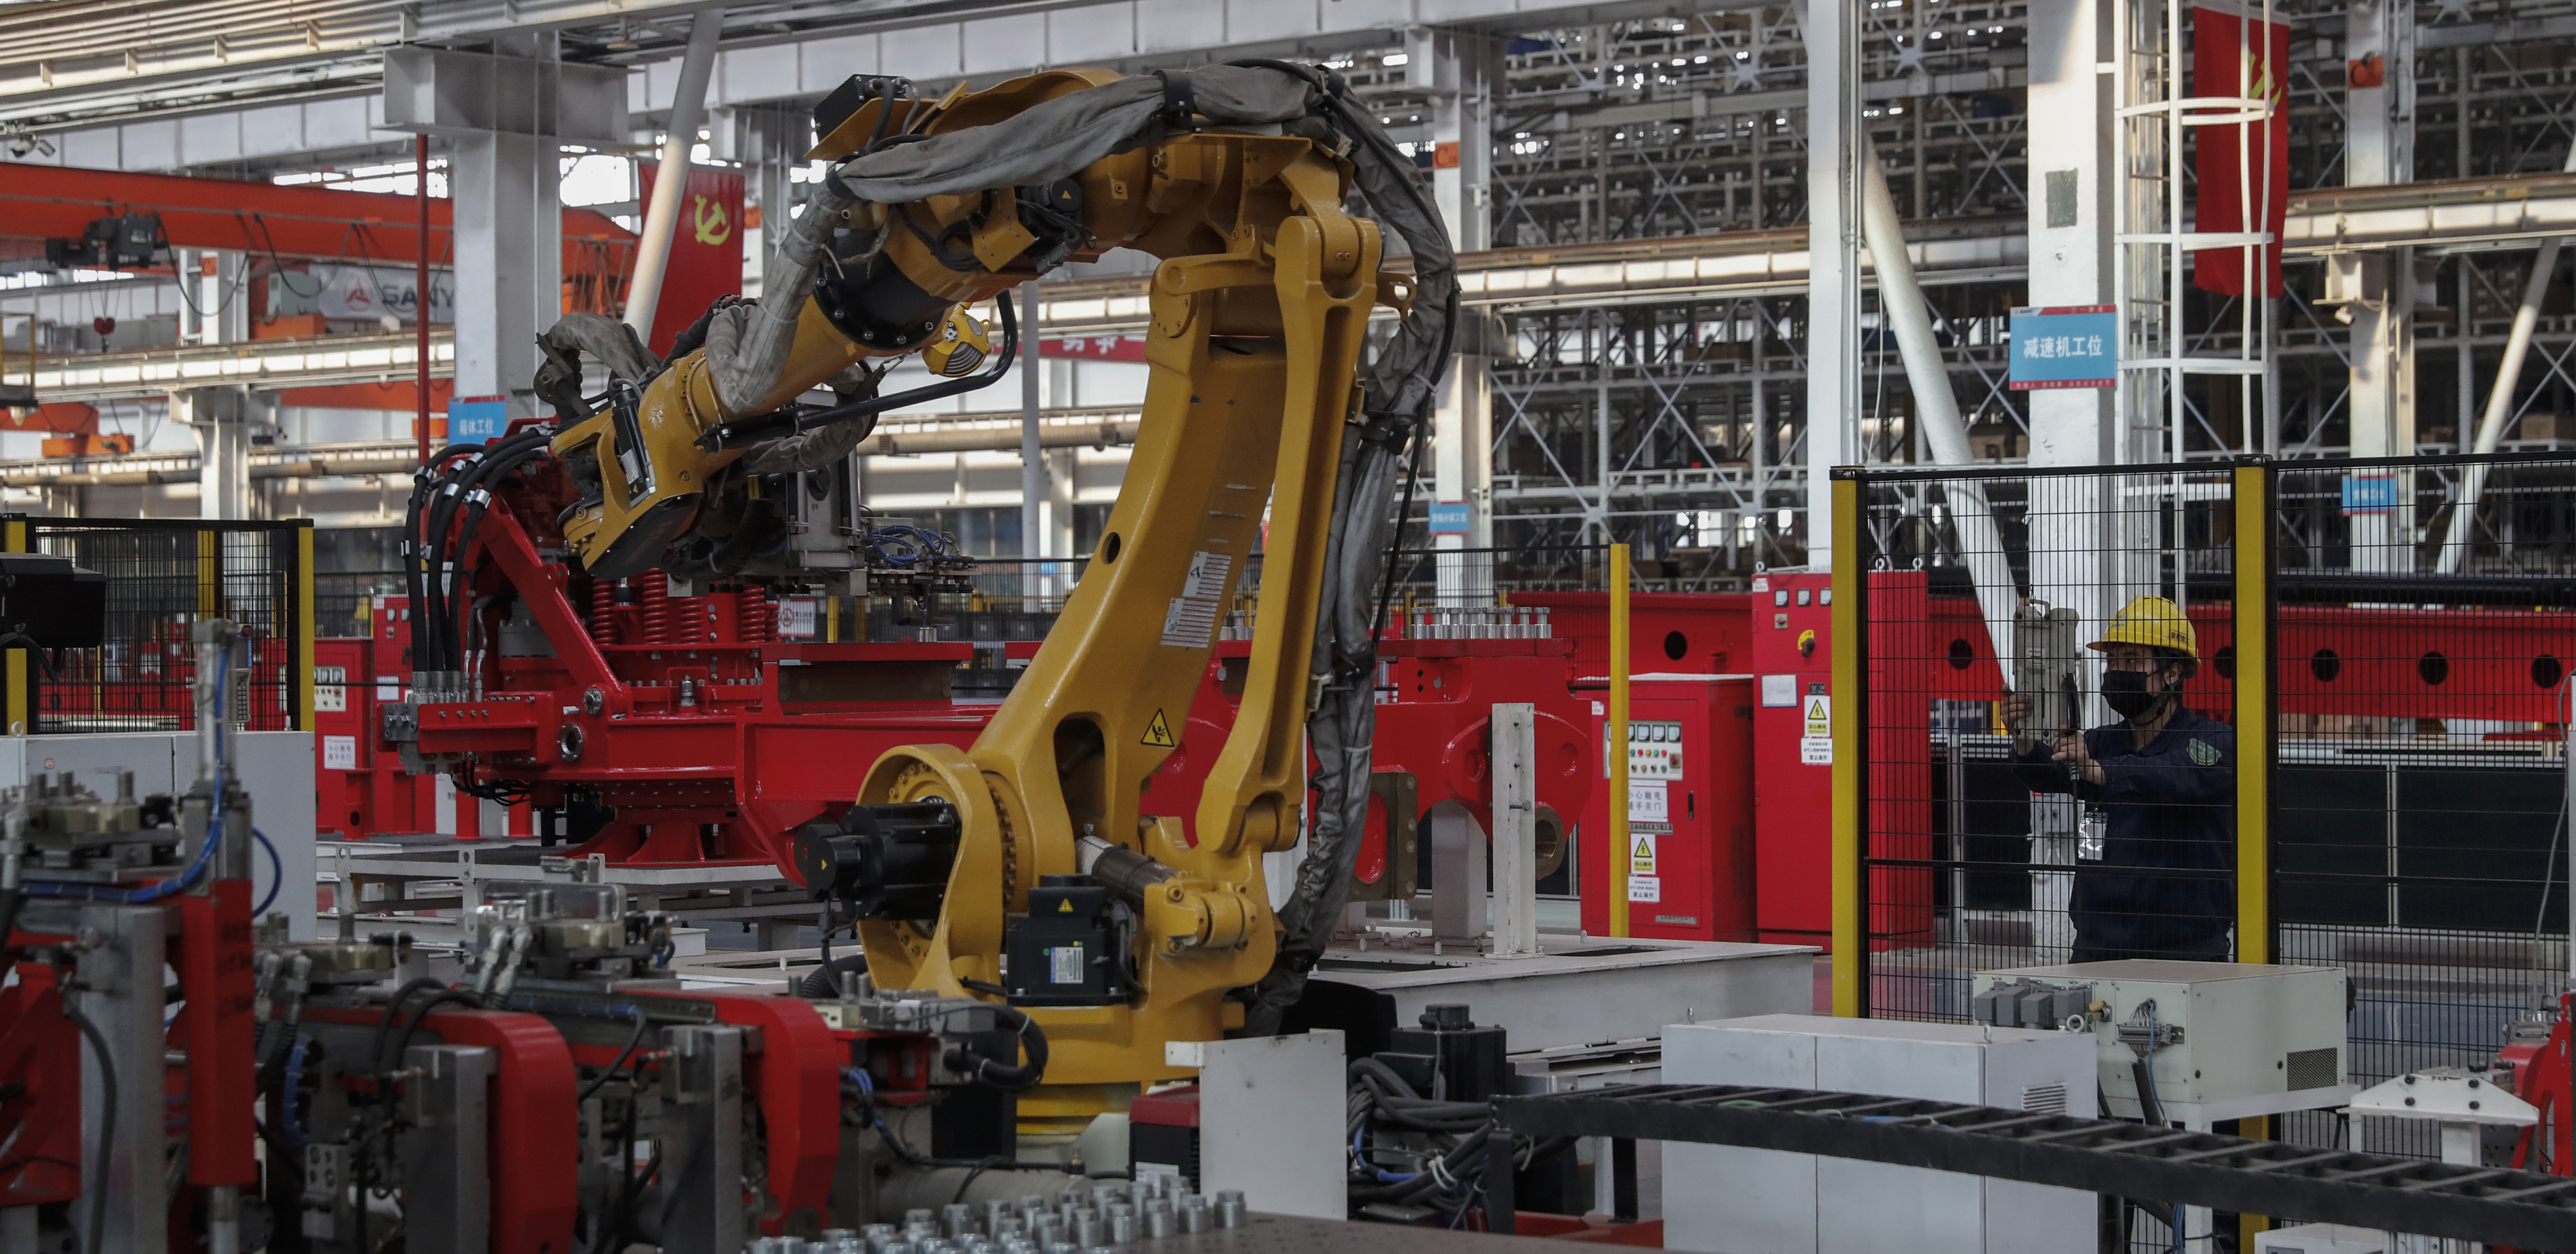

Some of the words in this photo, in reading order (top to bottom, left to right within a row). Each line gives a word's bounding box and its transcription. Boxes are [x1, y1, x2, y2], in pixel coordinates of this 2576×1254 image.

[2023, 335, 2103, 358] 减速机工位
